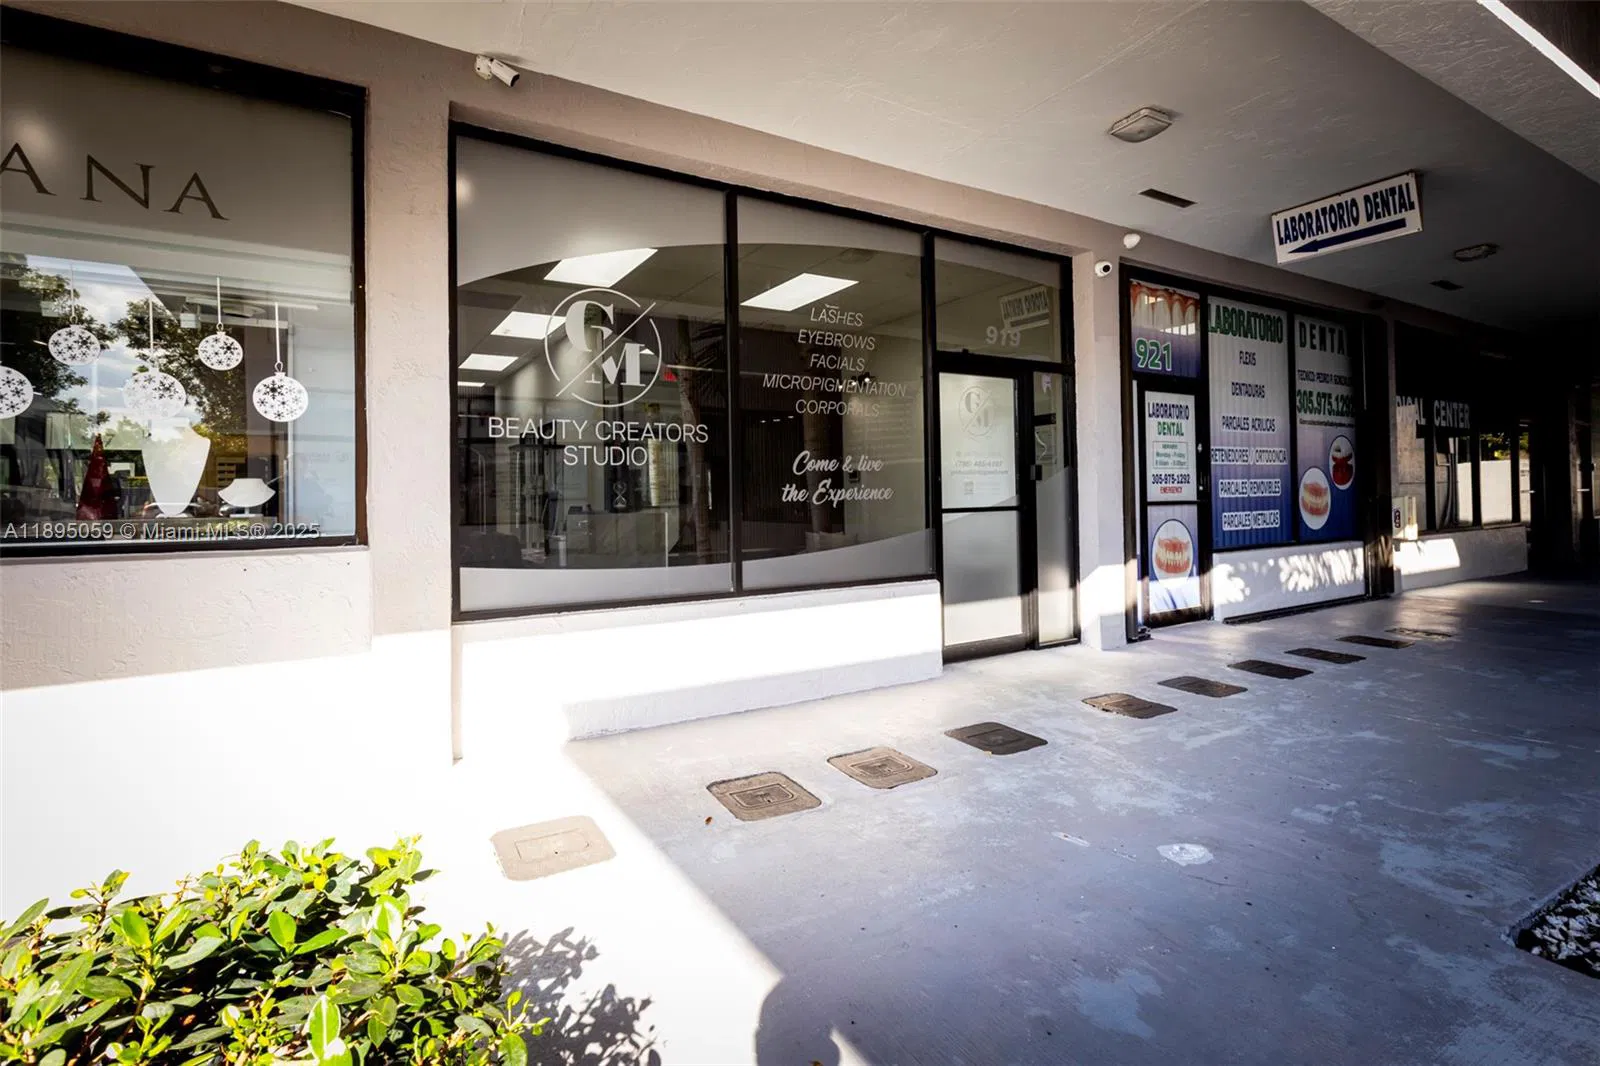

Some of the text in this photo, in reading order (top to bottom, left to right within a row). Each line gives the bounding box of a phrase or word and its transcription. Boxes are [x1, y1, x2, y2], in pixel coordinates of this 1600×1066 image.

[1276, 182, 1416, 246] LABORATORIO DENTAL
[810, 307, 864, 327] LASHES
[1208, 303, 1284, 344] LABORATORIO
[798, 329, 876, 351] EYEBROWS
[986, 325, 1021, 347] 919
[809, 353, 866, 372] FACIALS
[1135, 338, 1173, 372] 921
[762, 374, 907, 397] MICROPIGMENTATION
[1231, 381, 1265, 399] DENTADURAS
[795, 399, 881, 418] CORPORALS
[1148, 402, 1188, 420] LABORATORIO
[1433, 400, 1471, 429] CENTER
[488, 417, 709, 443] BEAUTY CREATORS
[1158, 421, 1184, 436] DENTAL
[563, 445, 649, 467] STUDIO
[792, 450, 885, 475] Come & live
[1152, 473, 1189, 485] 305-975-1292
[782, 478, 895, 508] the Experience
